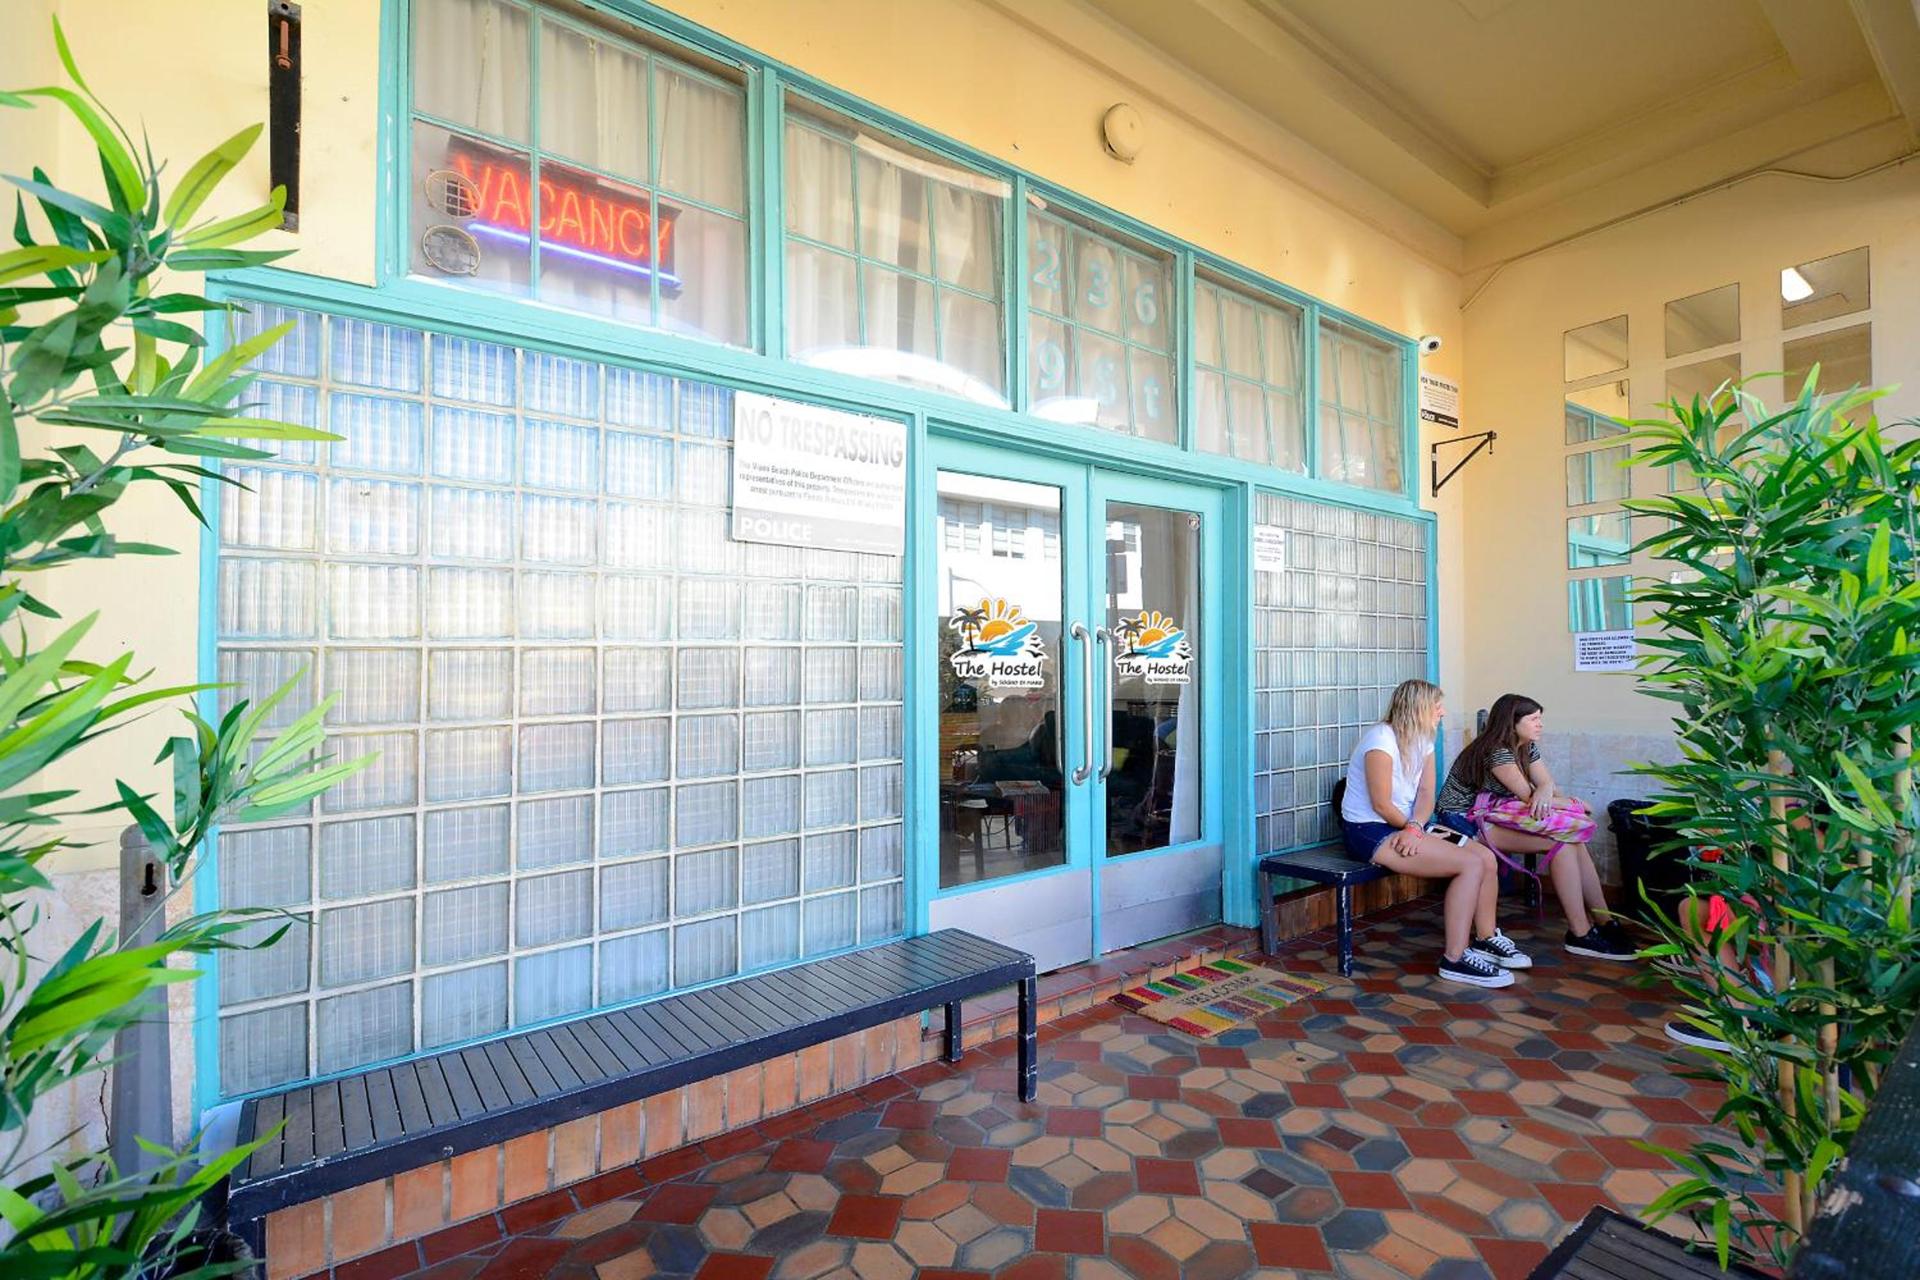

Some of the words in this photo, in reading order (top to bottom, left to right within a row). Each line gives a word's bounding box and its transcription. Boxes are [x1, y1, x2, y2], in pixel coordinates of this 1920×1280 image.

[455, 153, 672, 264] VACANCY
[1031, 237, 1158, 327] 236
[739, 405, 774, 446] NO
[779, 414, 904, 469] TRESPASSING
[739, 515, 814, 542] POLICE
[954, 660, 985, 675] The
[991, 661, 1042, 676] Hostel
[1117, 661, 1142, 674] The
[1147, 662, 1189, 675] Hostel
[991, 679, 998, 687] by
